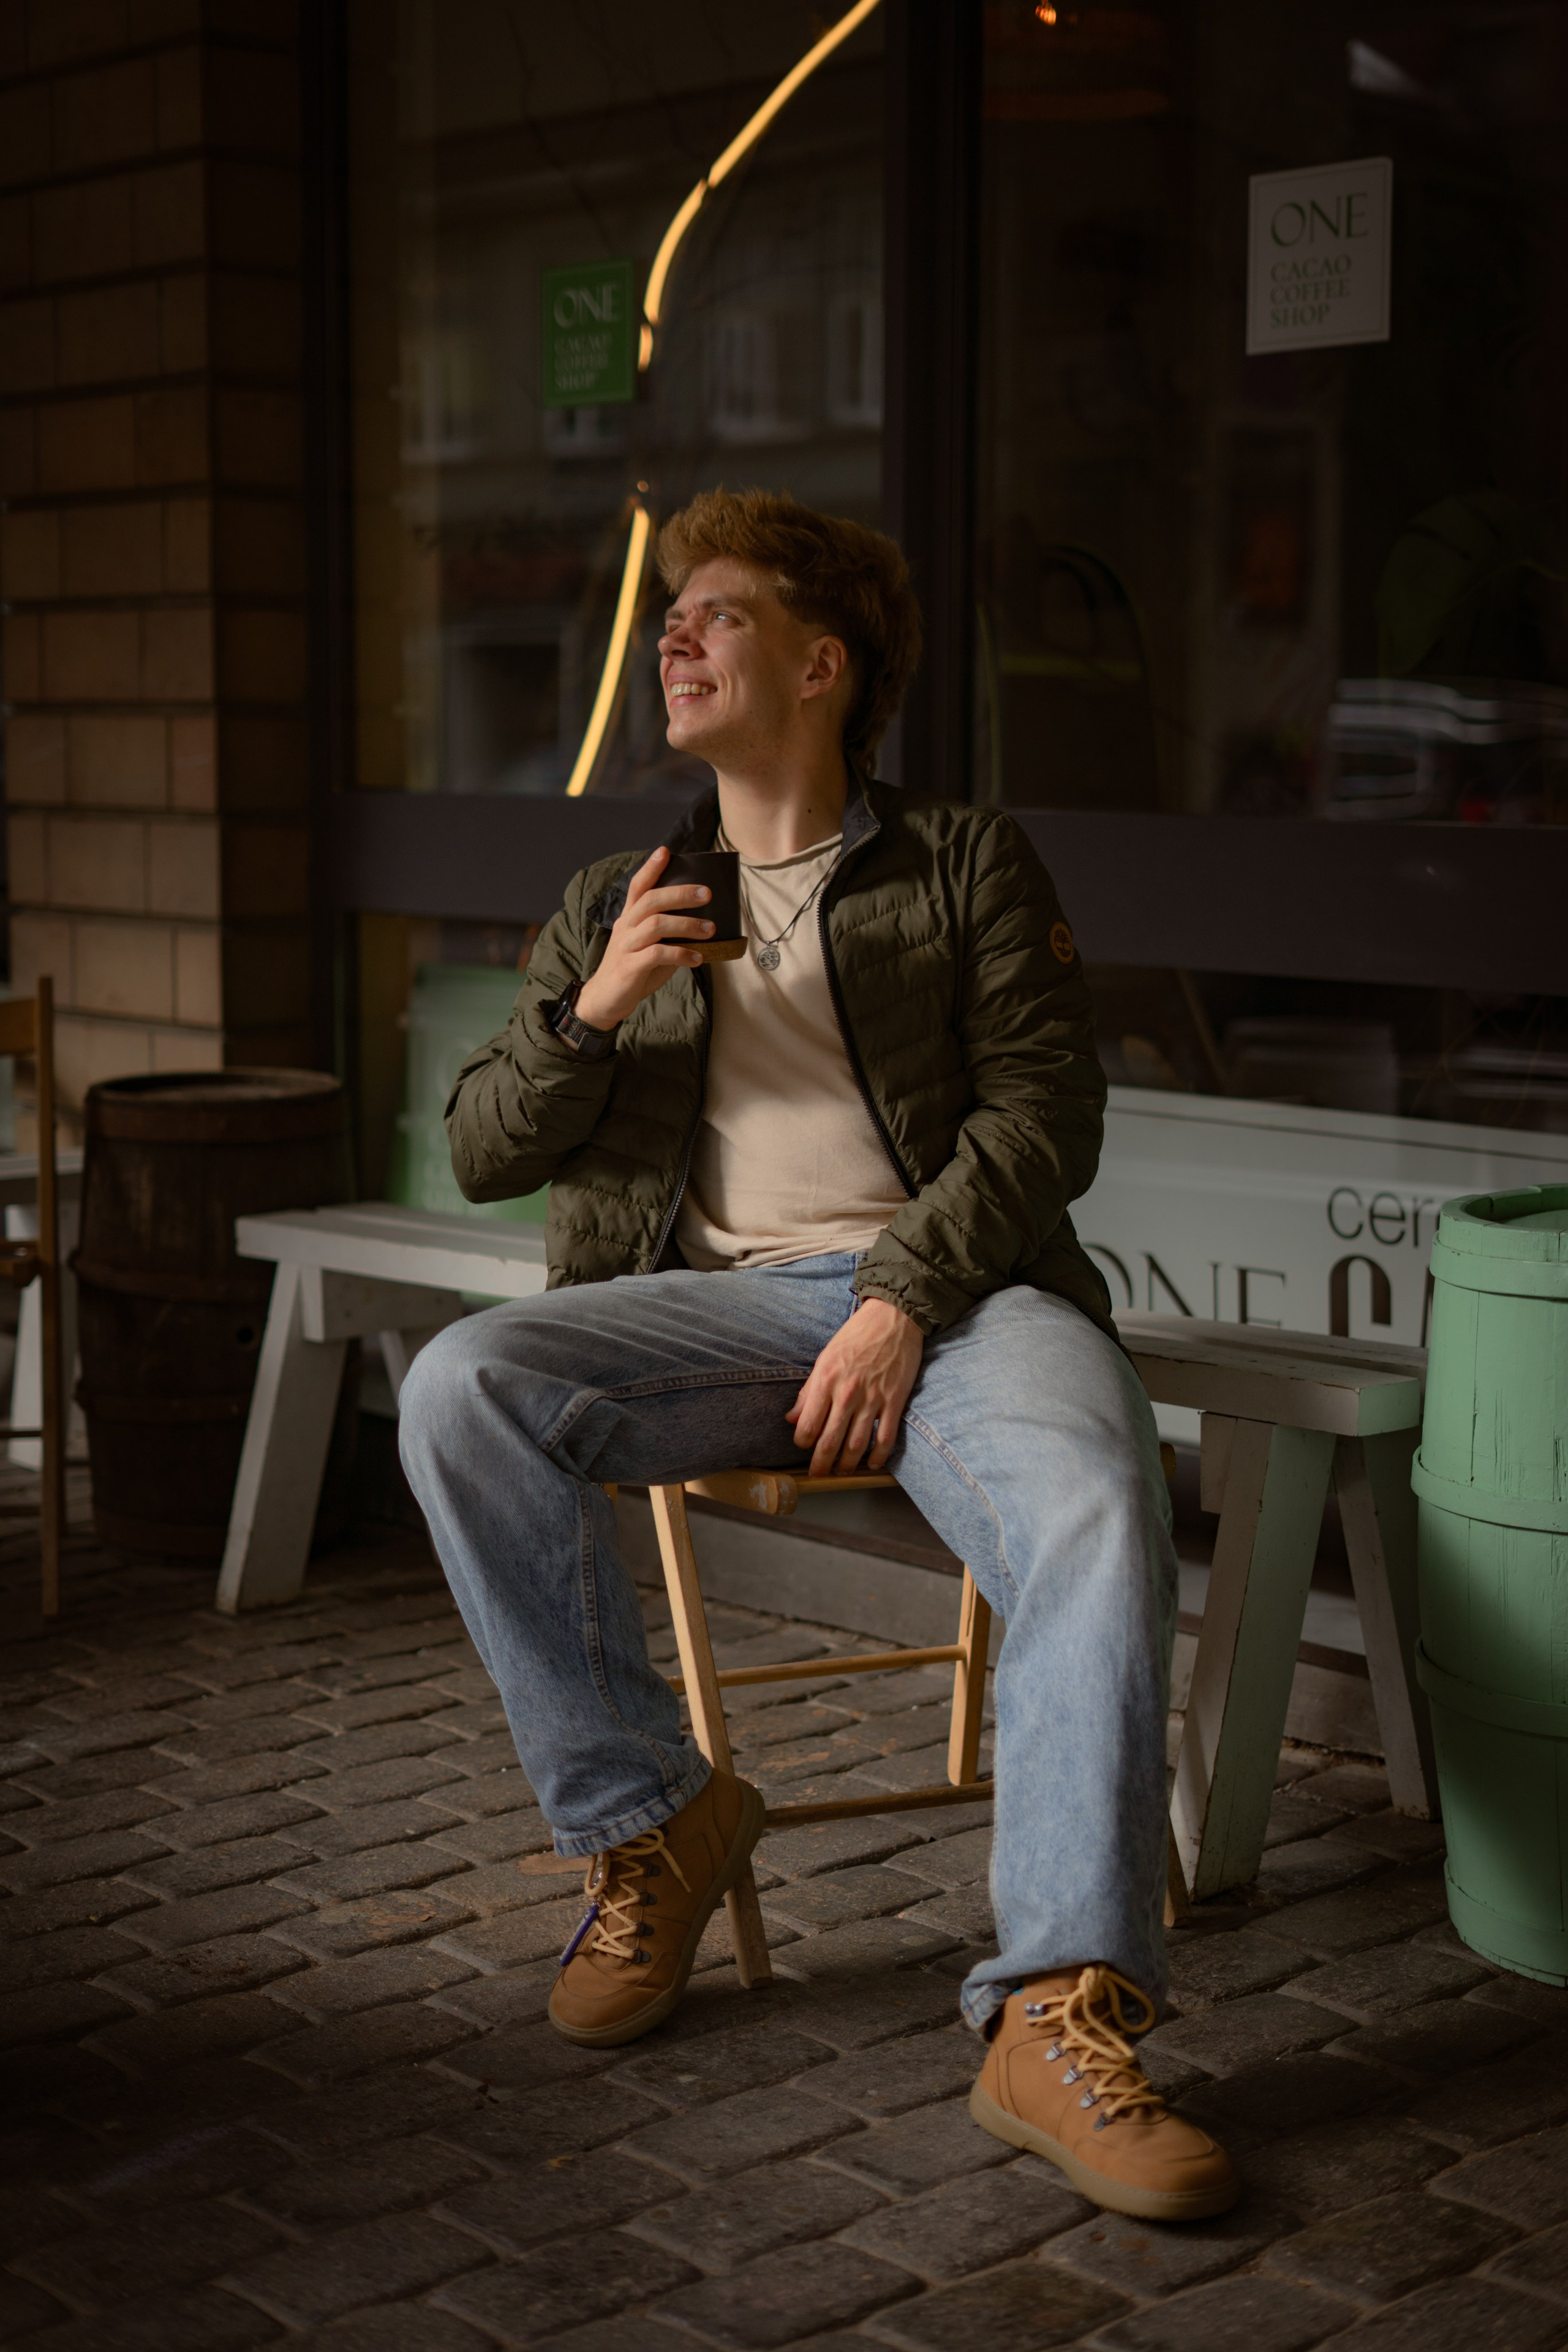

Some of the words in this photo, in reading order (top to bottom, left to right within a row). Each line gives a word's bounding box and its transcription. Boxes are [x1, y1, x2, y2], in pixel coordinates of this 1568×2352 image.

[1270, 191, 1369, 247] ONE
[1270, 253, 1352, 283] CACAO
[554, 282, 621, 330] ONE
[1270, 279, 1351, 305] COFFEE
[1270, 303, 1331, 329] SHOP
[1328, 1186, 1441, 1248] cer
